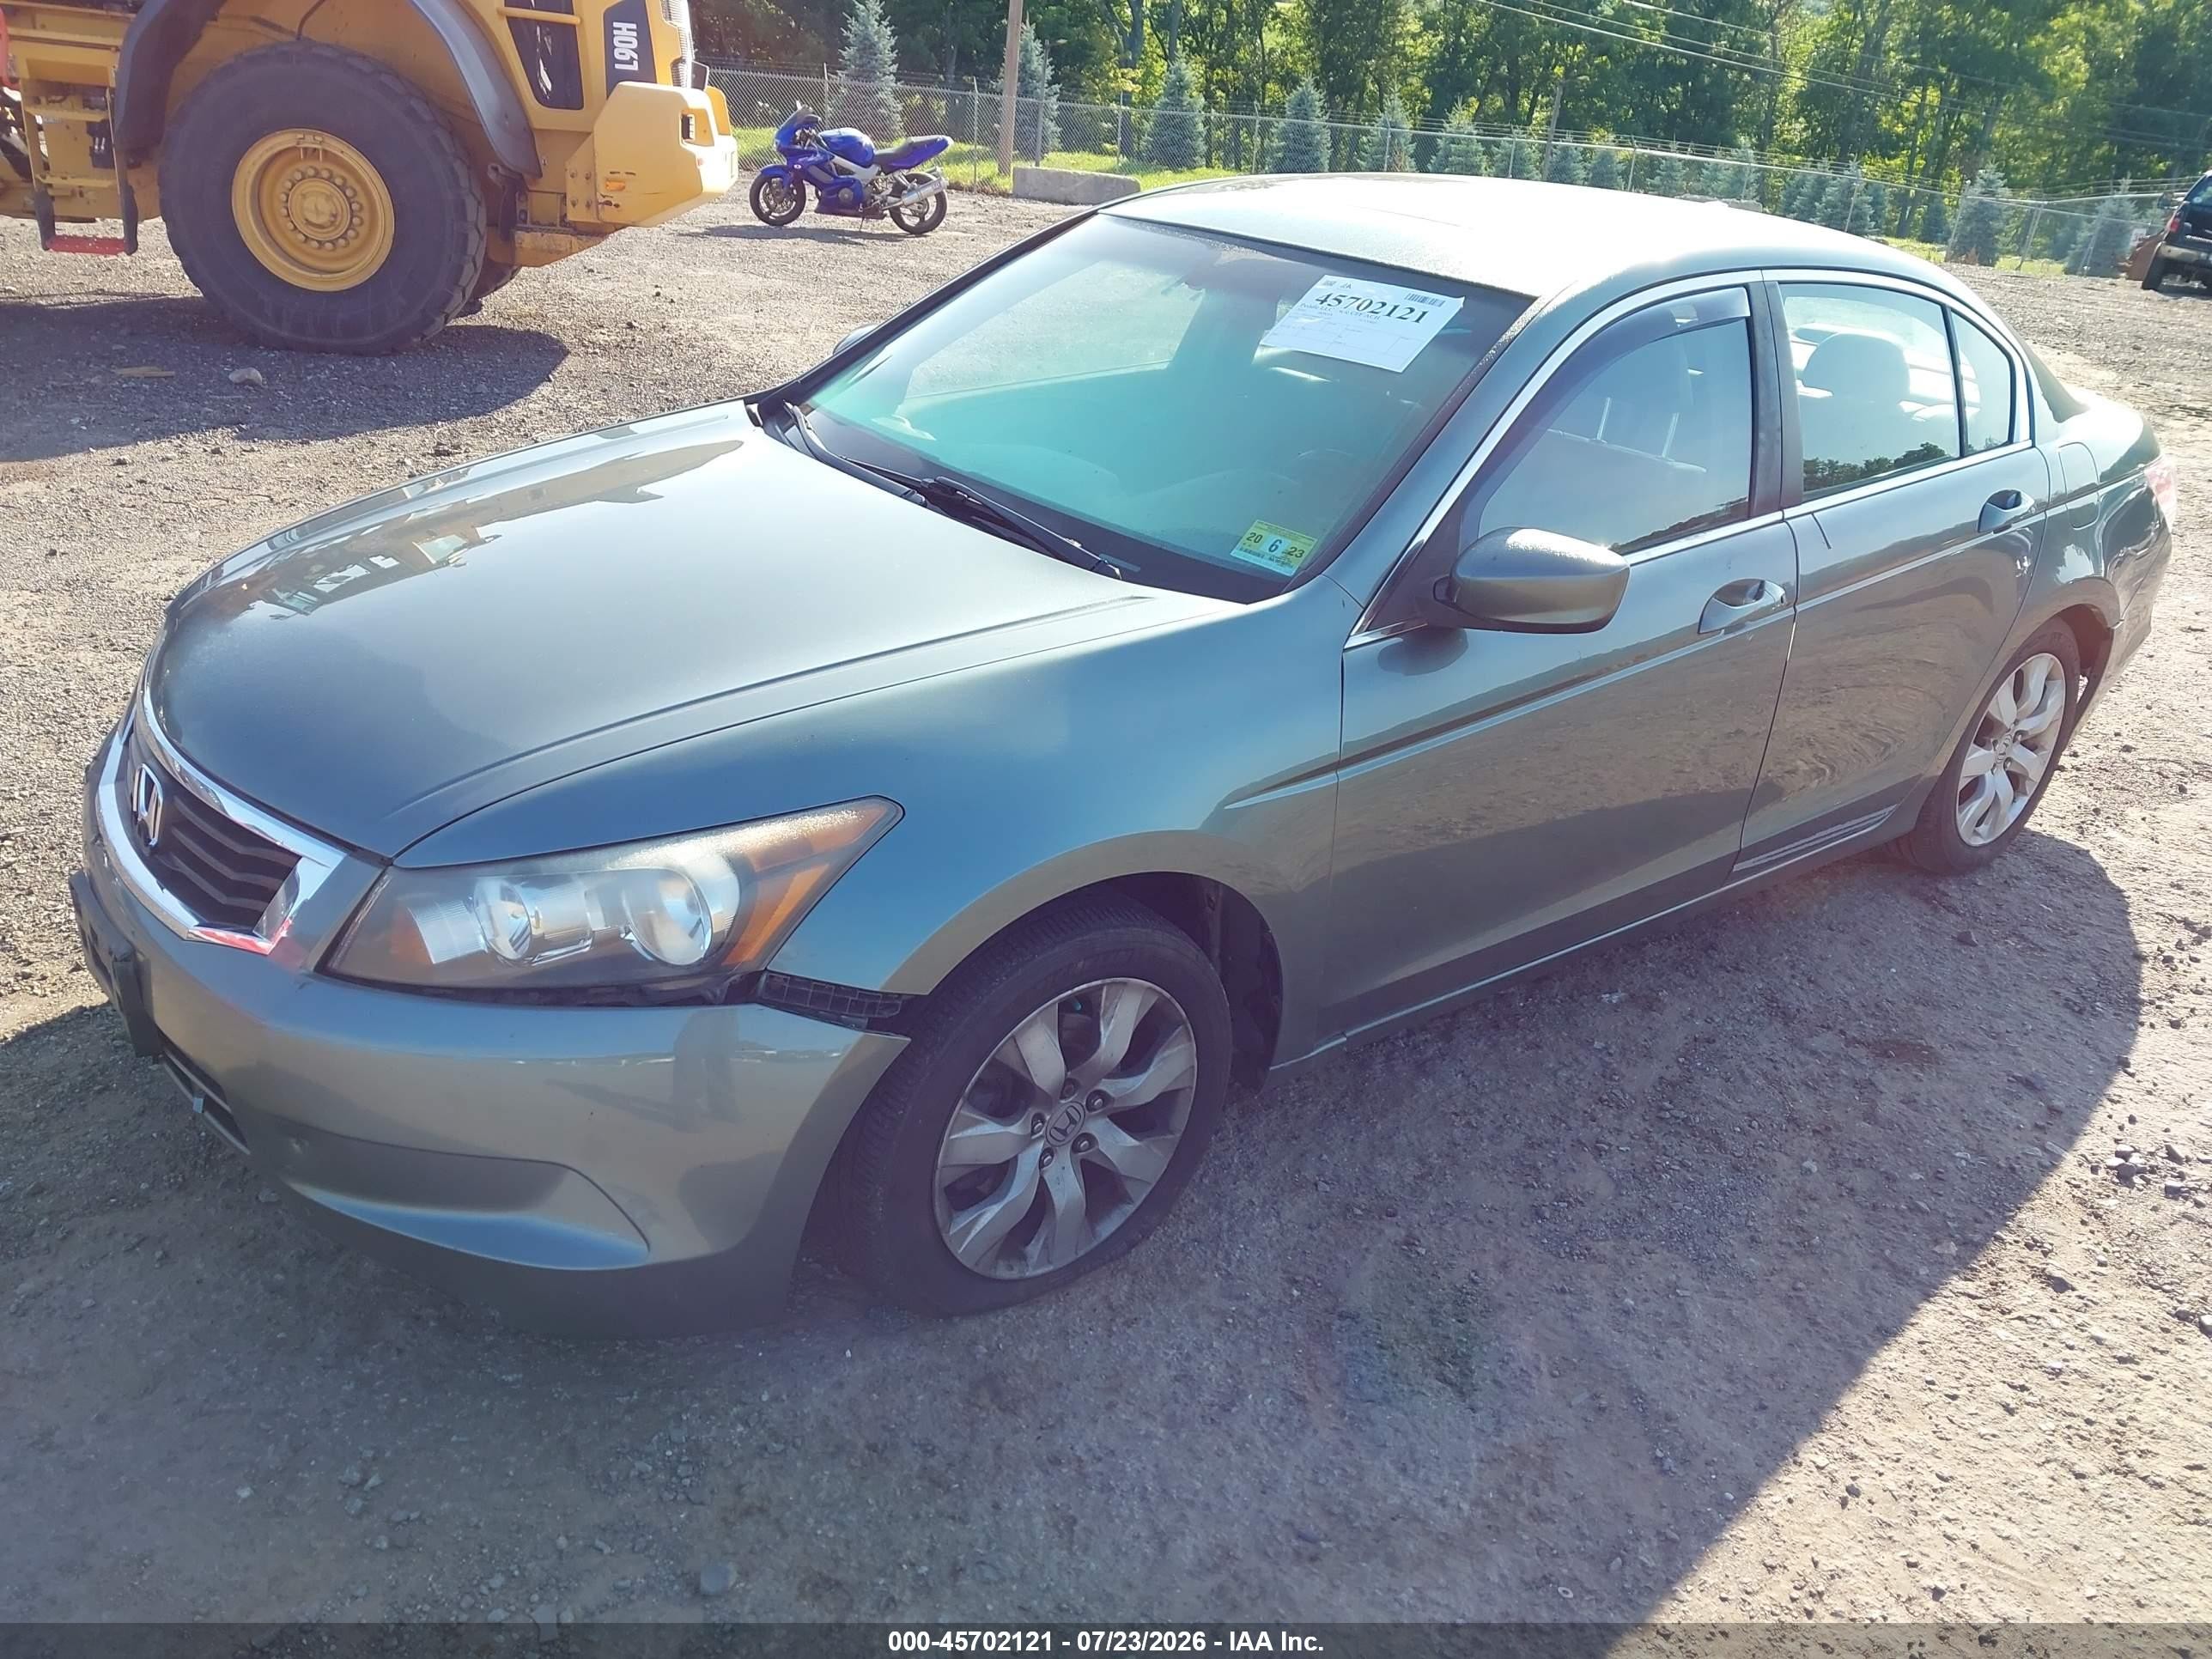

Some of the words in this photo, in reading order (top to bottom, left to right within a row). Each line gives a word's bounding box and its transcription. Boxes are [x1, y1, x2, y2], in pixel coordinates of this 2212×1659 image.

[612, 21, 639, 71] L90H
[1316, 293, 1429, 324] 45702121
[1246, 532, 1263, 544] 20
[1268, 538, 1283, 553] 6
[1288, 546, 1305, 558] 23
